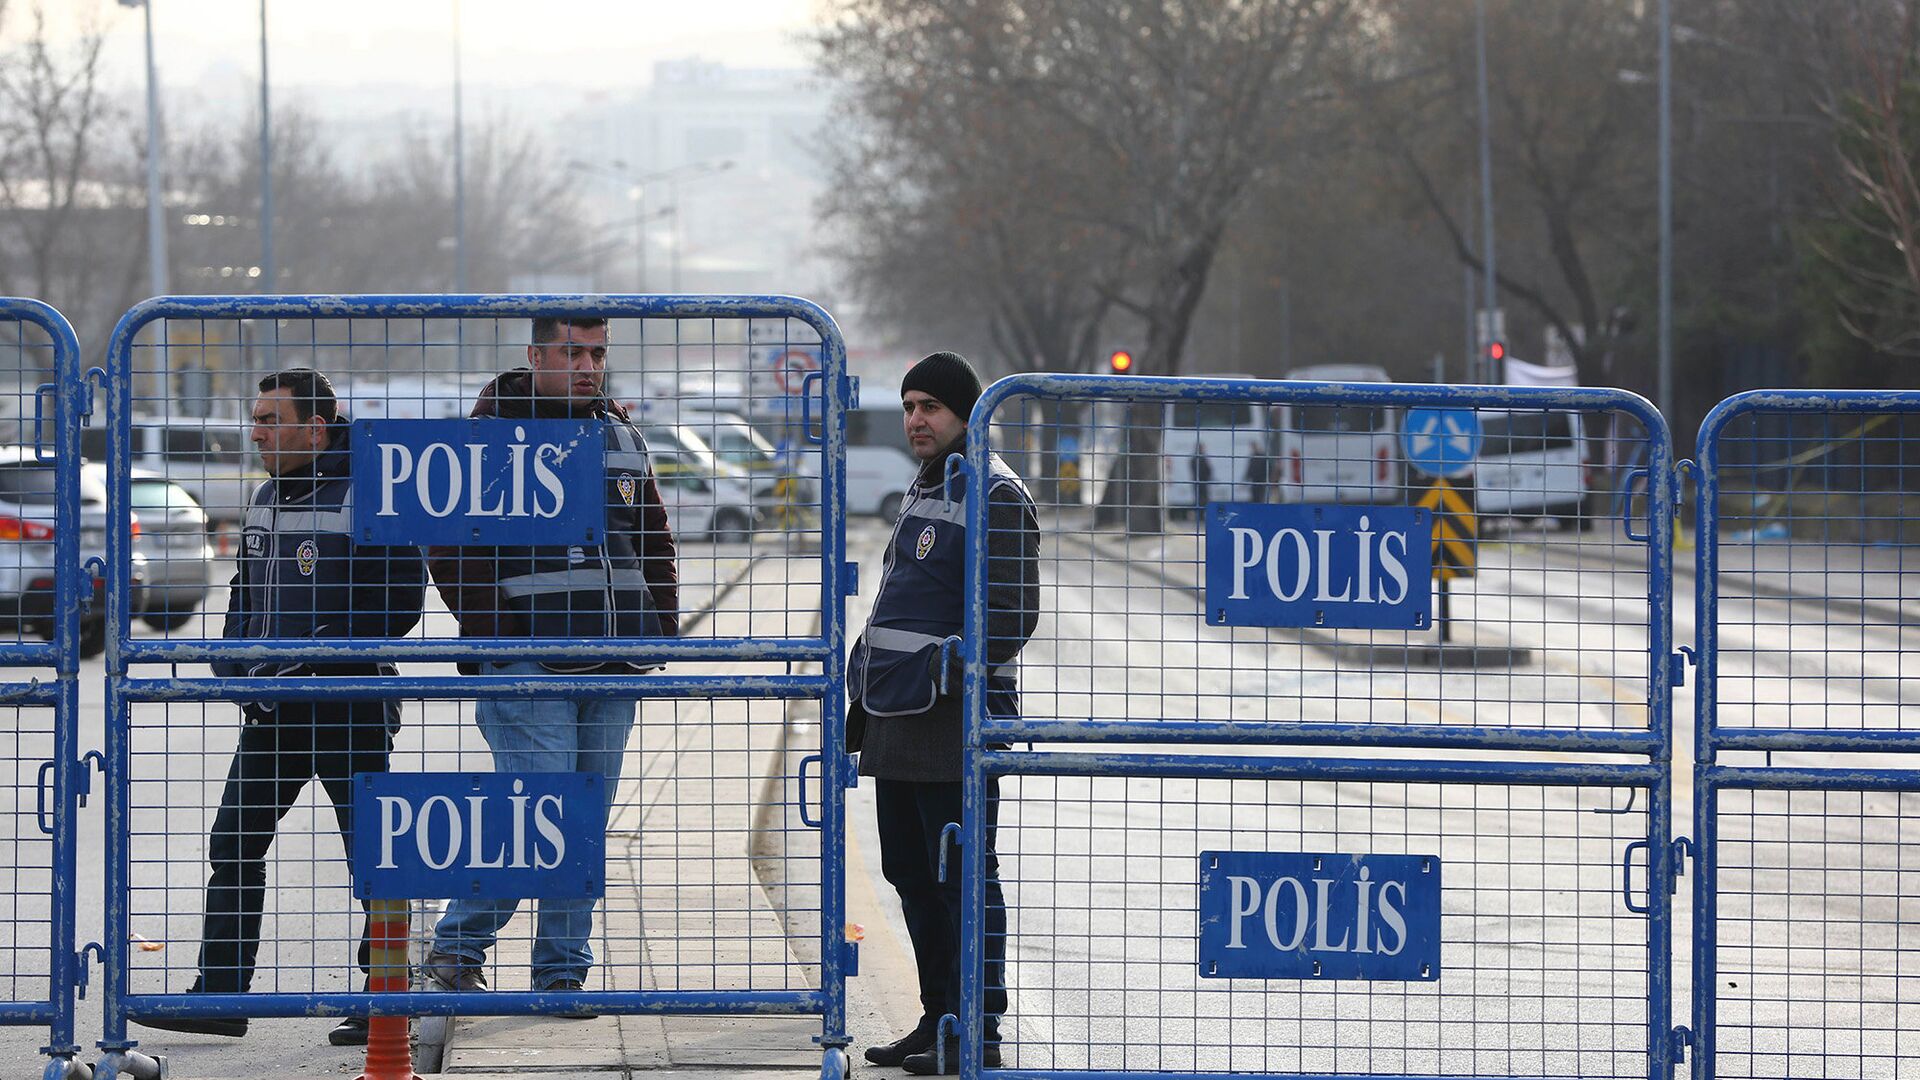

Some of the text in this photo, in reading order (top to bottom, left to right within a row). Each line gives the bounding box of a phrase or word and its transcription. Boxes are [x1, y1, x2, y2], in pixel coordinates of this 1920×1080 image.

[376, 426, 565, 519] POLİS
[1228, 515, 1410, 605] POLİS
[375, 778, 565, 870] POLİS
[1225, 865, 1407, 956] POLİS
